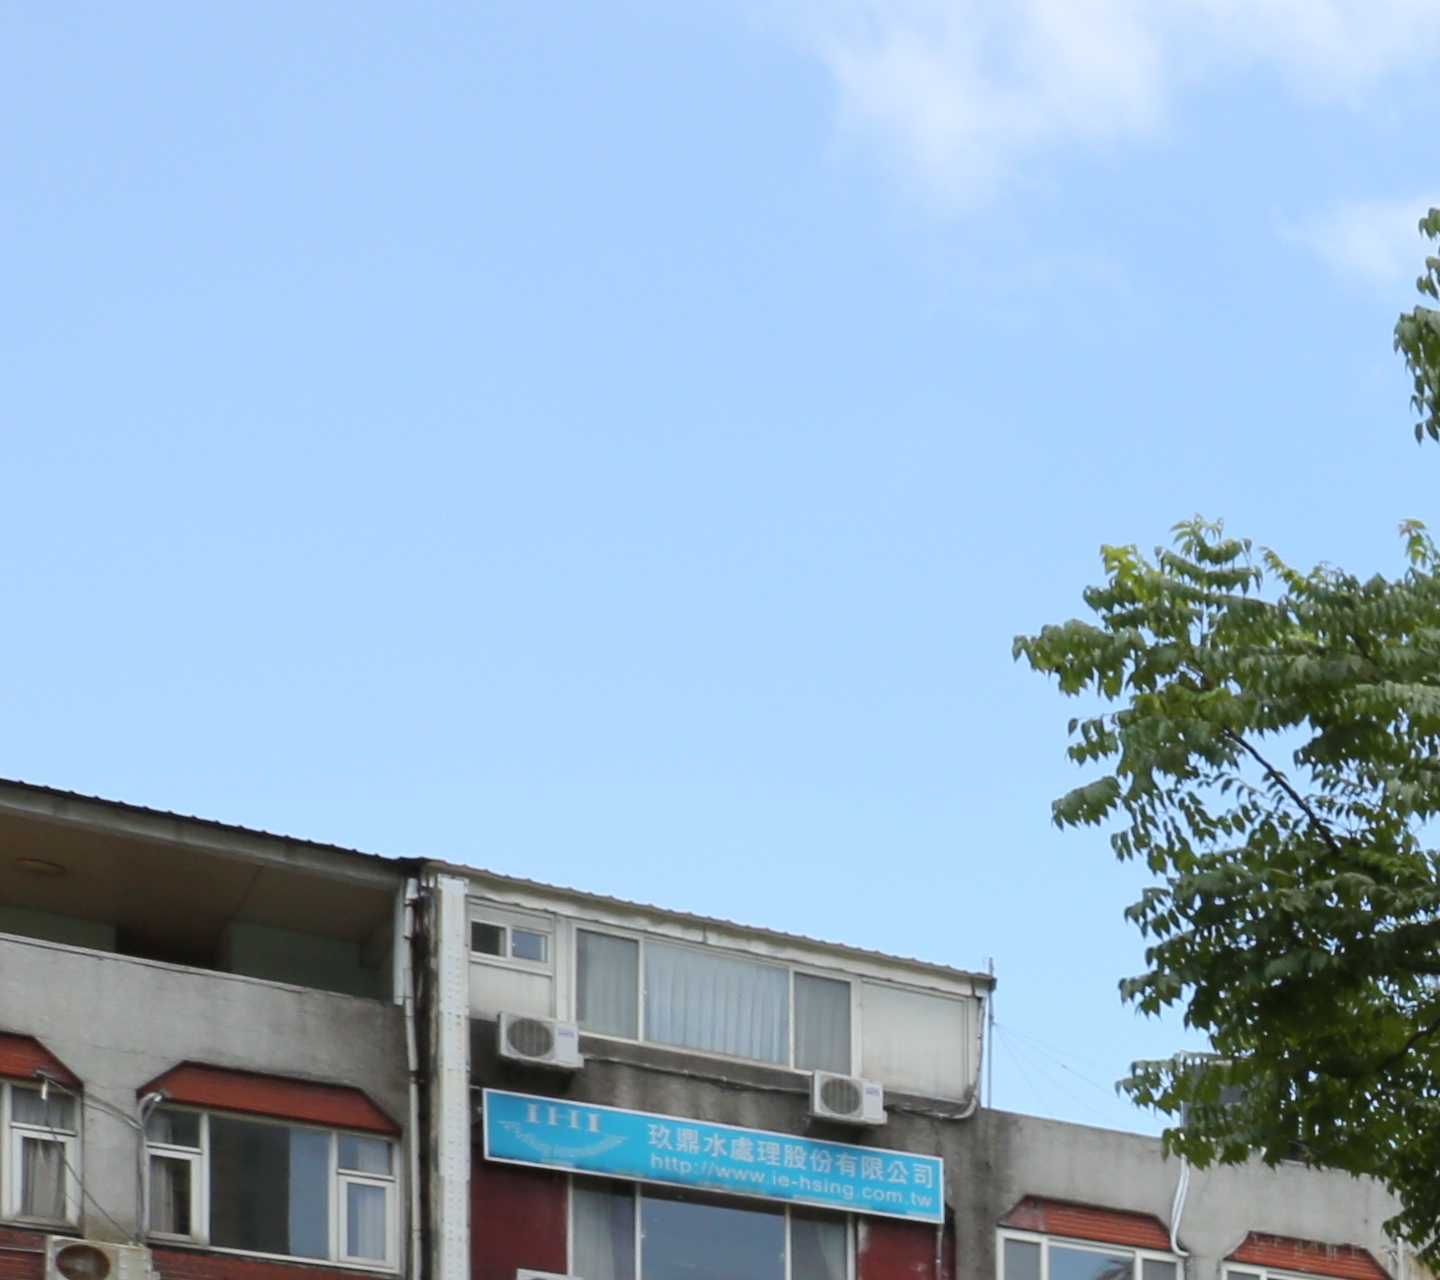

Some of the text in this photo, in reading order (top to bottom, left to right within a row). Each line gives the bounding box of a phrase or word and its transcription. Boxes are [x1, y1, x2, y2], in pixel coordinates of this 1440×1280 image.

[526, 1103, 601, 1132] IHI
[648, 1123, 935, 1190] 玖鼎水處理股份有限公司
[651, 1153, 933, 1208] http://www.ie-hsing.com.tw
